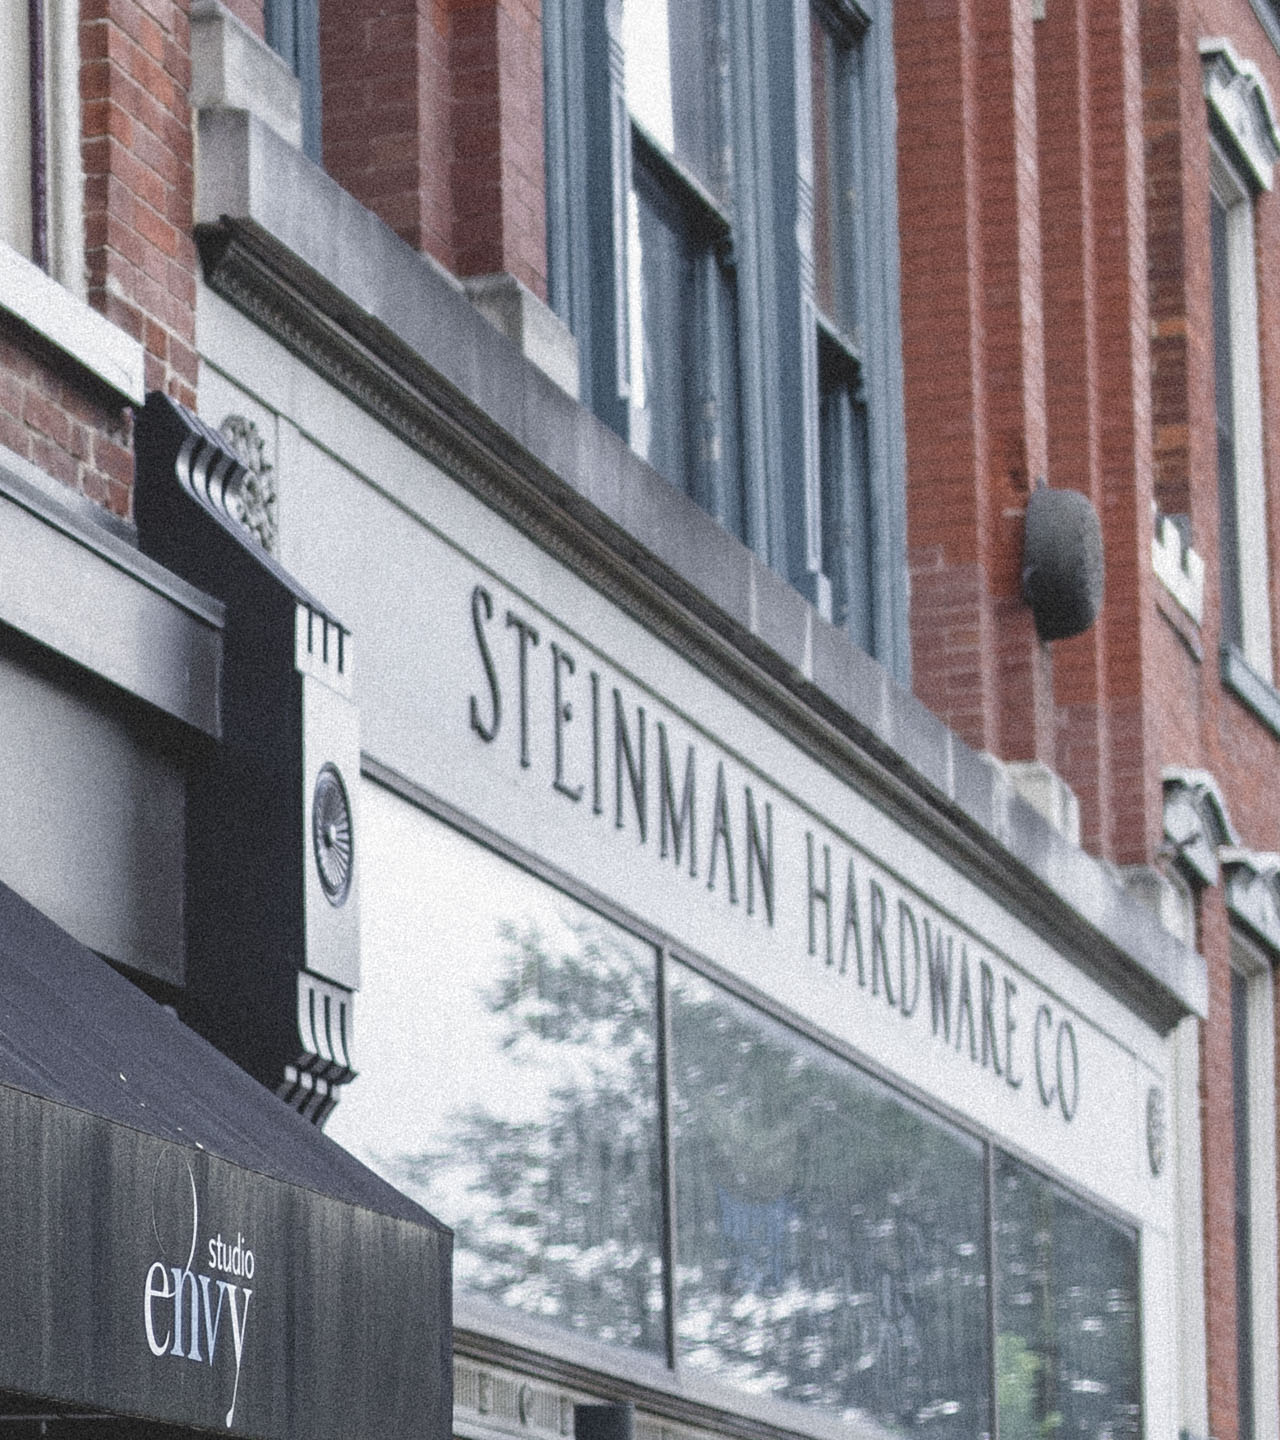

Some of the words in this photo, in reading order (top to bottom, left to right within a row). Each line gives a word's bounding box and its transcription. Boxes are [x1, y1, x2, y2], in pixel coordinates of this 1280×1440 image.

[470, 584, 774, 928] STEINMAN
[806, 830, 1023, 1090] HARDWARE
[1035, 1003, 1079, 1123] CO
[208, 1232, 255, 1280] studio
[144, 1261, 253, 1428] envy
